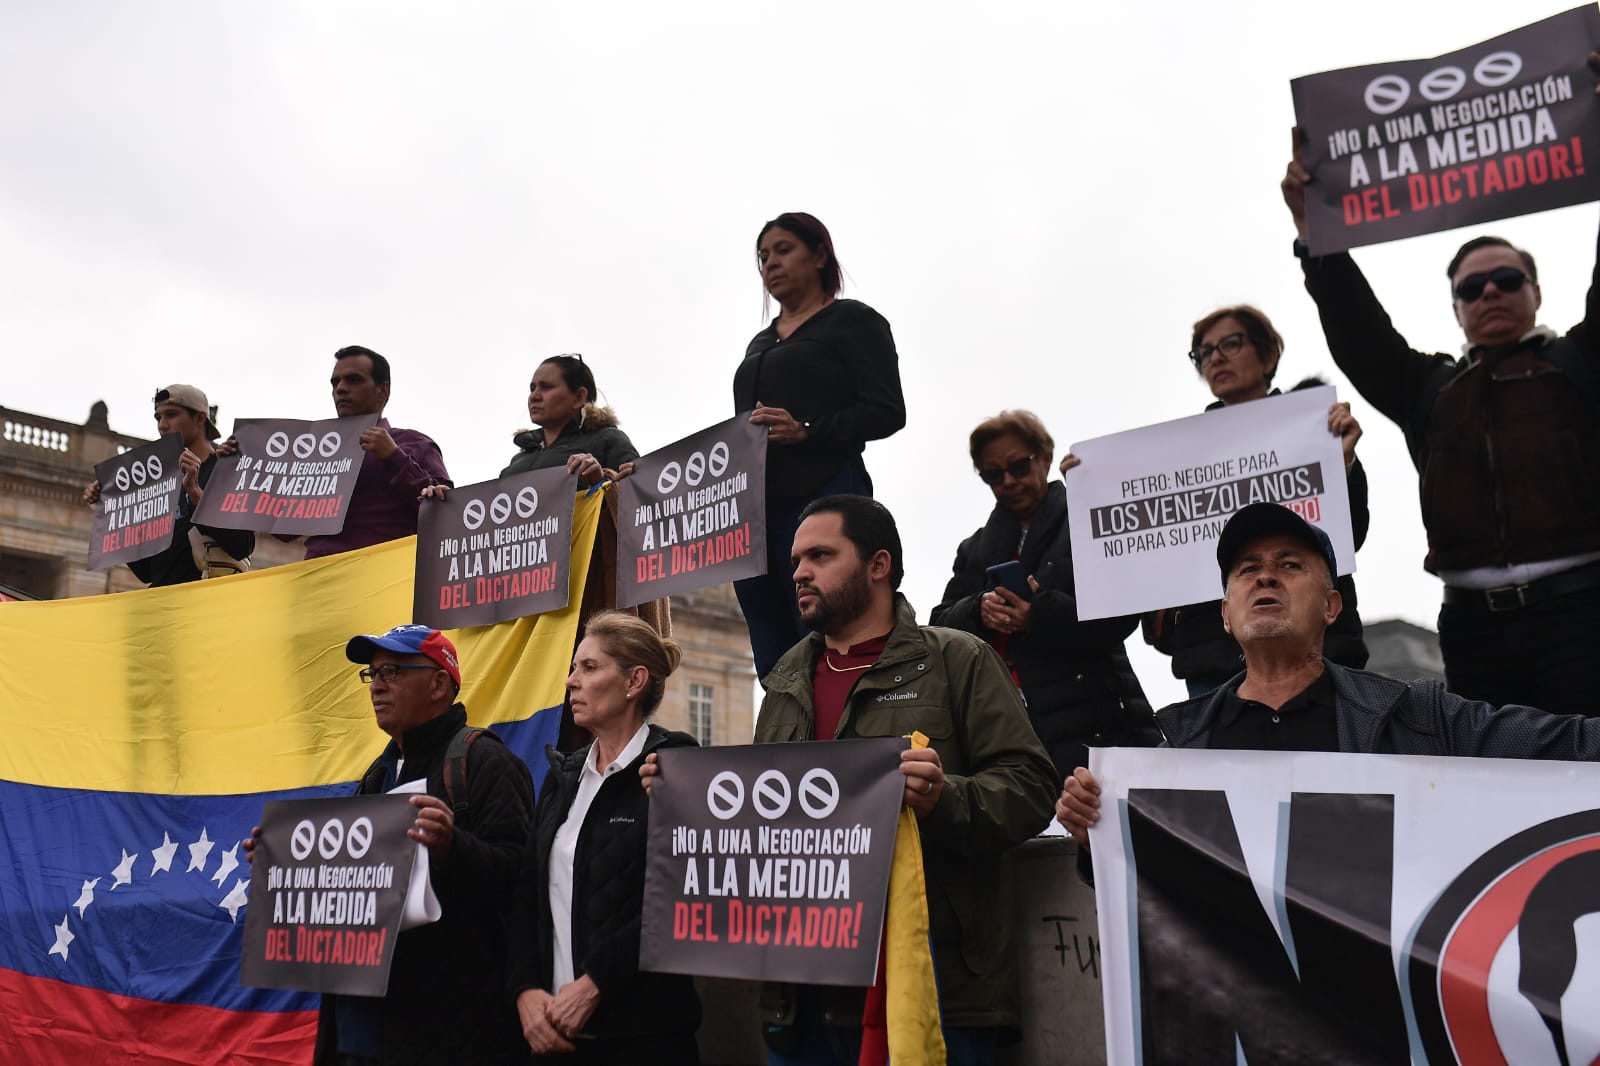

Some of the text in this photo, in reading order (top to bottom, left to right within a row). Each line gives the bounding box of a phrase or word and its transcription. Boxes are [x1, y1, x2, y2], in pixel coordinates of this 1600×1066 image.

[1350, 108, 1558, 188] A LA MEDIDA
[1368, 125, 1381, 148] A
[1385, 113, 1427, 141] UNA
[1342, 136, 1585, 226] DEL DICTADOR!
[235, 470, 338, 495] A LA MEDIDA
[253, 459, 262, 470] A
[264, 461, 288, 474] UNA
[1121, 450, 1279, 498] PETRO: NEGOCIE PARA
[108, 512, 115, 531] A
[118, 507, 130, 528] LA
[133, 494, 169, 523] MEDIDA
[118, 497, 122, 509] A
[124, 492, 135, 507] UNA
[220, 492, 249, 512] DEL
[655, 502, 661, 519] A
[663, 495, 683, 517] UNA
[1097, 503, 1139, 536] LOS
[1143, 468, 1318, 527] VENEZOLANOS,
[642, 497, 739, 551] A LA MEDIDA
[102, 532, 120, 553] DEL
[448, 538, 547, 581] A LA MEDIDA
[461, 537, 467, 553] A
[470, 532, 490, 550] UNA
[636, 521, 750, 584] DEL DICTADOR!
[1103, 539, 1123, 558] NO
[1127, 531, 1165, 554] PARA
[1169, 527, 1188, 546] SU
[440, 561, 557, 609] DEL DICTADOR!
[884, 691, 917, 700] Columbia
[702, 829, 713, 854] A
[718, 828, 751, 854] UNA
[284, 867, 291, 888] A
[294, 867, 315, 888] UNA
[683, 857, 850, 900] A LA MEDIDA
[273, 891, 376, 925] A LA MEDIDA
[673, 899, 863, 949] DEL DICTADOR!
[265, 924, 386, 966] DEL DICTADOR!
